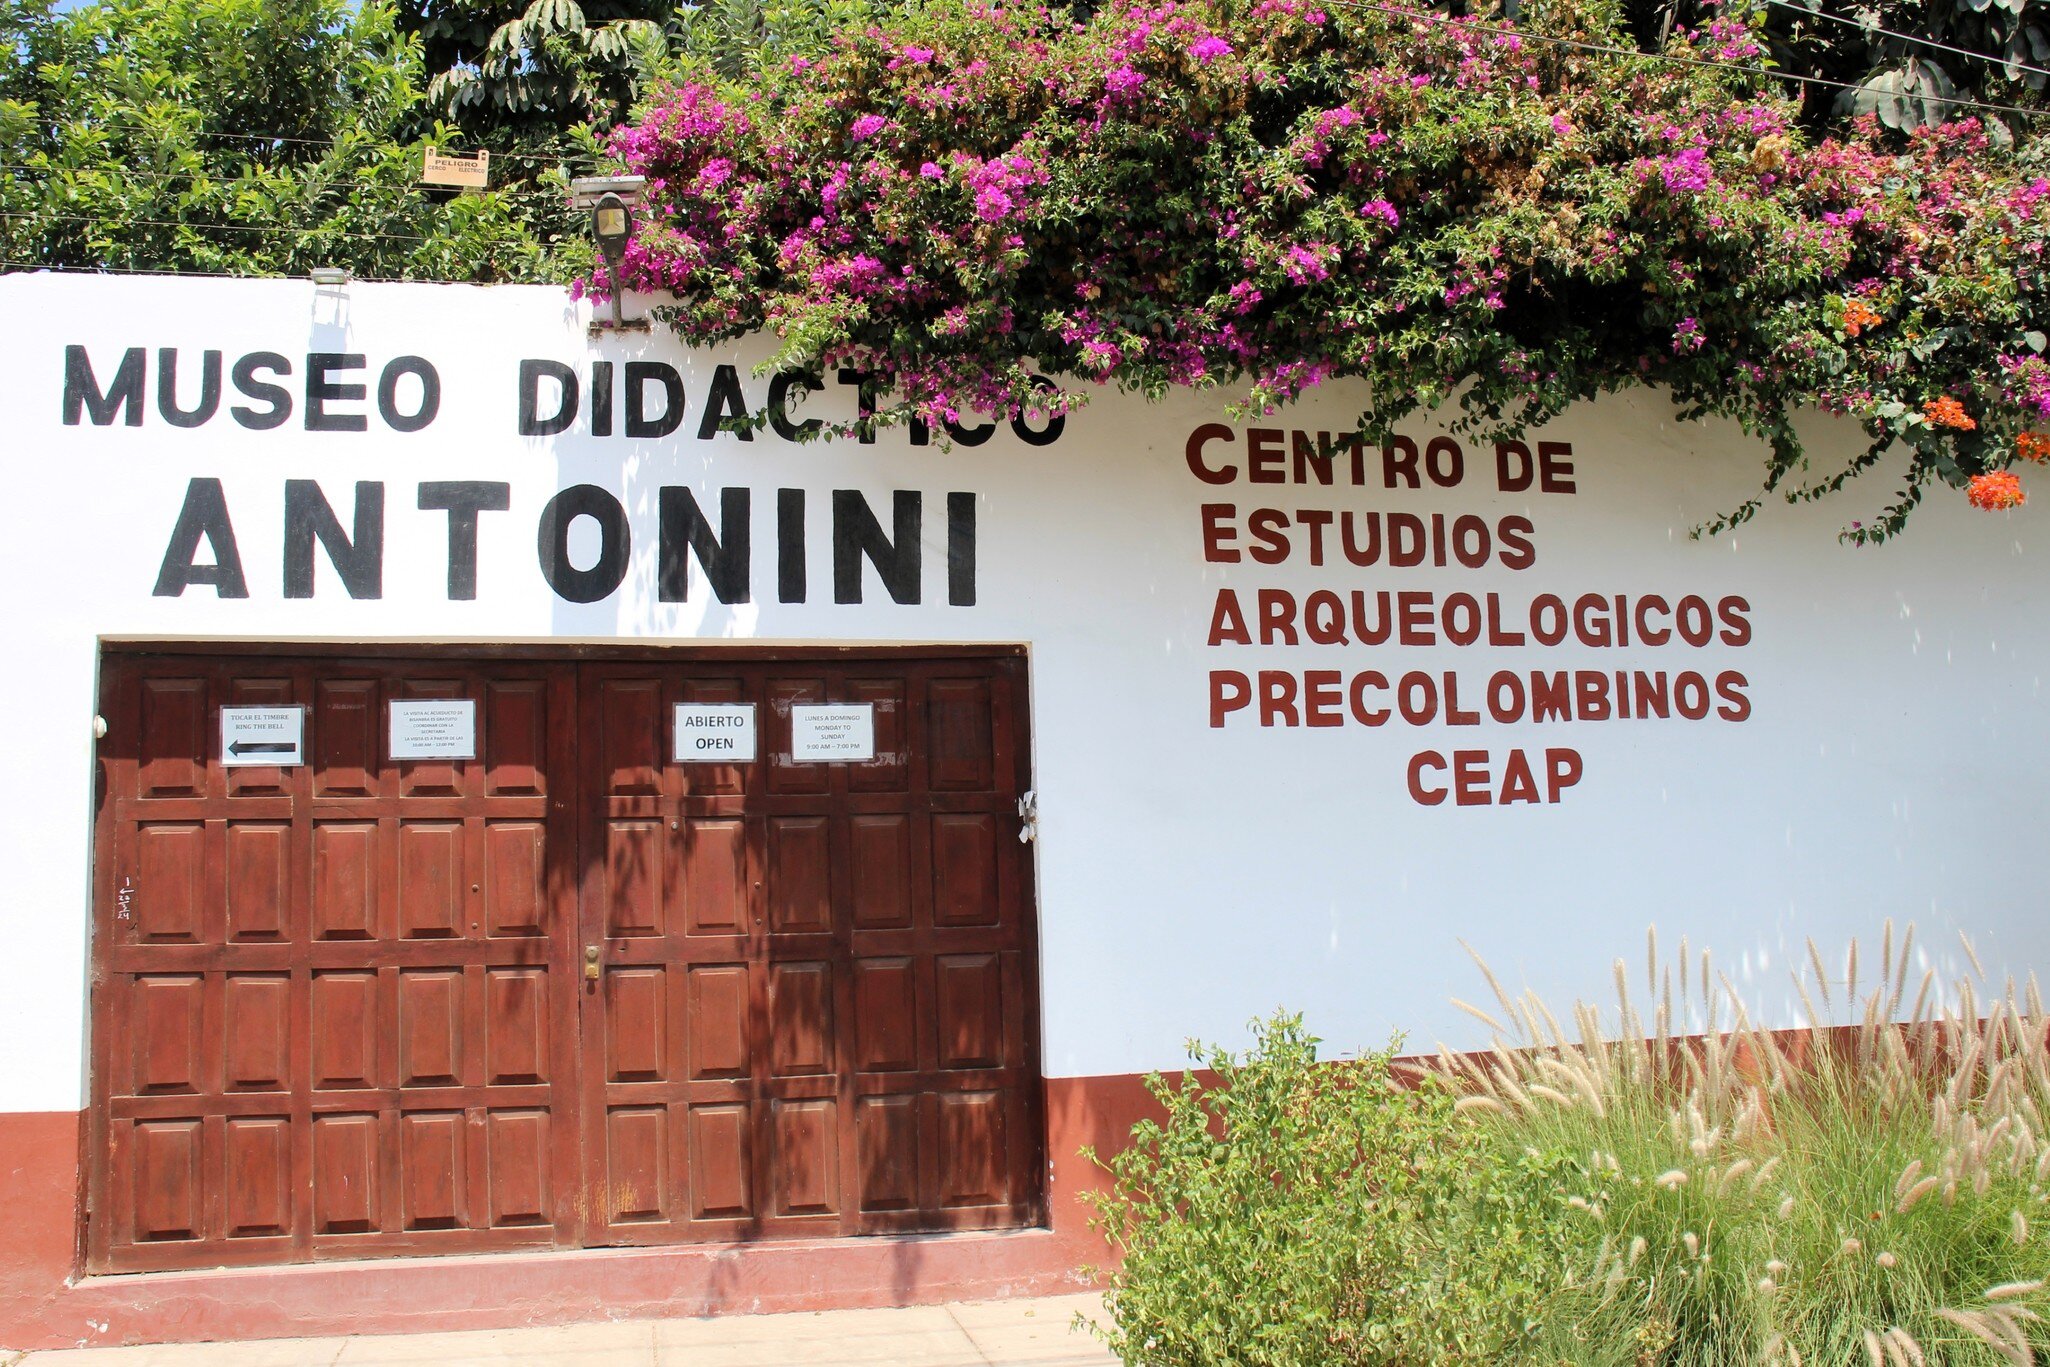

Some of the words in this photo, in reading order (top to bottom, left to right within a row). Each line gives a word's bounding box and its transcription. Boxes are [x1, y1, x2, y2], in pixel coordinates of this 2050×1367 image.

[435, 160, 478, 168] PELIGRO
[62, 344, 441, 432] MUSEO
[1185, 422, 1464, 489] CENTRO
[1495, 438, 1577, 494] DE
[152, 477, 977, 607] ANTONINI
[1200, 503, 1537, 571] ESTUDIOS
[1206, 587, 1753, 648] ARQUEOLOGICOS
[685, 715, 744, 728] ABIERTO
[1208, 669, 1753, 729] PRECOLOMBINOS
[695, 737, 734, 750] OPEN
[1406, 747, 1584, 806] CEAP
